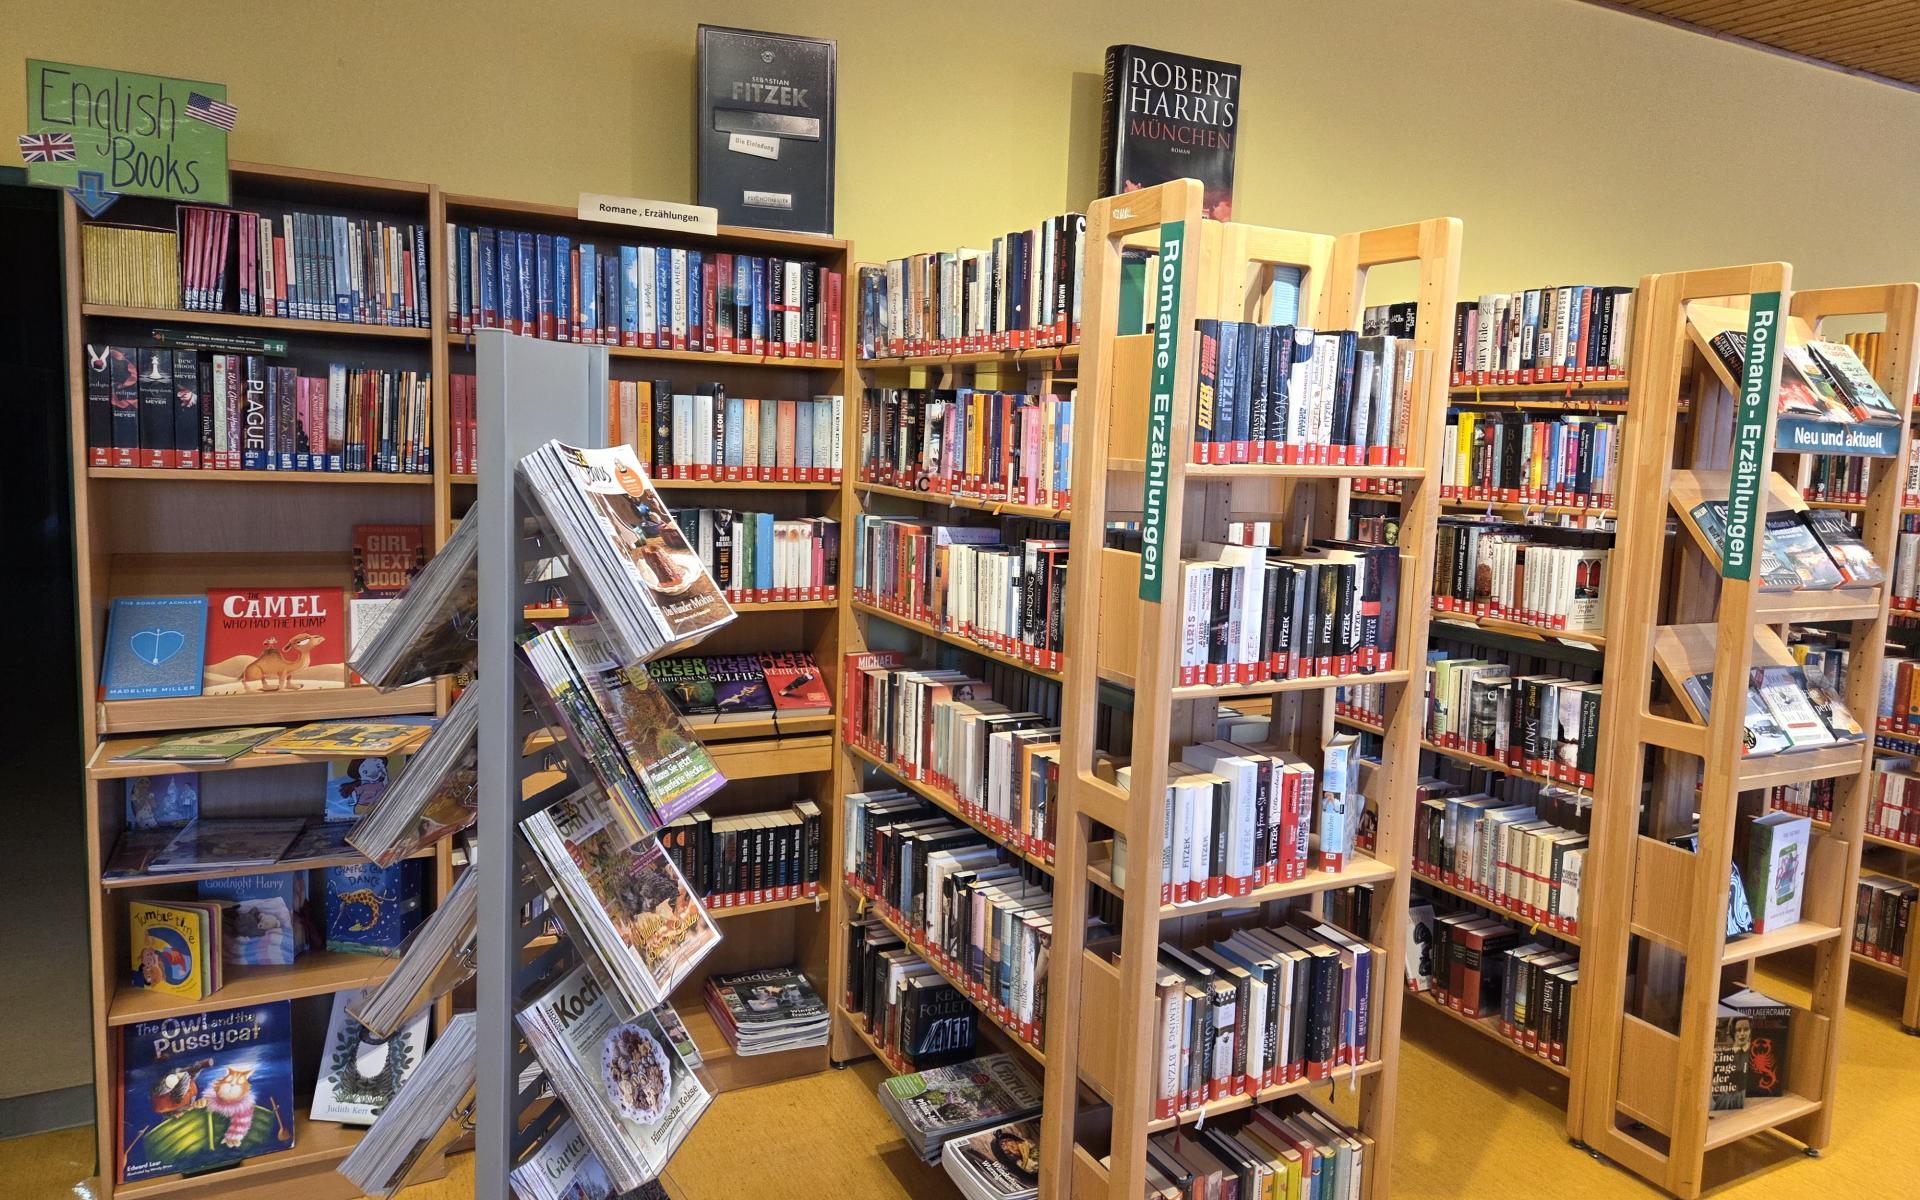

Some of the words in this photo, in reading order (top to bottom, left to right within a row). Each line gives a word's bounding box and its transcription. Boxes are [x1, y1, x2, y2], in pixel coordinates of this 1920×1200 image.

[752, 76, 789, 86] SEBASTIAN
[1132, 58, 1236, 99] ROBERT
[732, 82, 808, 107] FITZEK
[1130, 86, 1233, 127] HARRIS
[41, 67, 176, 156] English
[736, 137, 745, 145] Die
[747, 139, 774, 152] Einladung
[1131, 119, 1230, 149] MÜNCHEN
[112, 137, 200, 195] Books
[599, 203, 637, 215] Romane
[645, 209, 699, 222] Erzählungen
[1058, 284, 1066, 307] BROWN
[1156, 239, 1180, 369] Romane
[1745, 310, 1774, 407] Romane
[1222, 366, 1233, 422] FITZEK
[247, 380, 264, 450] PLAGUE
[1198, 382, 1214, 431] FITZEK
[1272, 391, 1288, 438] NOAH
[1323, 399, 1332, 428] FITZEK
[1253, 399, 1261, 442] SEBASTIAN
[1311, 403, 1320, 435] FITZEK
[716, 430, 724, 450] FALL
[1795, 427, 1818, 444] Neu
[1821, 430, 1844, 446] und
[1846, 431, 1883, 448] aktuell
[716, 451, 724, 465] DER
[918, 476, 930, 492] C
[1143, 393, 1169, 581] Erzählungen
[1727, 424, 1761, 566] Erzählungen
[367, 535, 410, 552] GIRL
[367, 554, 411, 569] NEXT
[223, 595, 327, 619] CAMEL
[690, 594, 715, 609] Mohn
[1025, 575, 1035, 629] BLENDUNG
[223, 618, 246, 630] WHO
[249, 618, 270, 629] HAD
[272, 617, 290, 629] THE
[293, 616, 326, 629] HUMP
[1186, 615, 1196, 655] AURIS
[1282, 616, 1290, 647] FITZEK
[1323, 612, 1332, 644] FITZEK
[1342, 612, 1350, 645] FITZEK
[650, 657, 705, 669] ADLER
[650, 666, 707, 677] OLSEN
[707, 663, 762, 675] OLSEN
[763, 666, 820, 677] VERRATEN
[858, 656, 894, 667] MICHAEL
[709, 671, 766, 684] SELFIES
[110, 687, 157, 695] MADELINE
[161, 685, 196, 693] MILLER
[1528, 684, 1537, 707] Schuld
[1524, 720, 1537, 753] LINK
[684, 765, 705, 779] Hecke
[1243, 829, 1251, 866] FITZEK
[1270, 826, 1278, 854] FITZEK
[1298, 821, 1306, 852] AURIS
[1182, 838, 1191, 868] FITZEK
[205, 877, 252, 894] Goodnight
[256, 877, 284, 891] Harry
[348, 875, 380, 887] DANCE
[133, 910, 174, 931] Tumble
[175, 912, 196, 946] time
[721, 968, 793, 985] Landlust
[936, 991, 963, 1002] KEN
[1542, 980, 1553, 1013] Mankell
[1753, 1007, 1791, 1017] LAGERCRANTZ
[136, 1022, 159, 1037] The
[161, 1013, 207, 1039] Owl
[211, 1014, 234, 1029] and
[236, 1011, 256, 1026] the
[154, 1024, 262, 1060] Pussycat
[1713, 1052, 1735, 1062] Eine
[1713, 1063, 1737, 1073] rage
[1713, 1074, 1730, 1083] der
[327, 1105, 351, 1114] Judith
[352, 1106, 369, 1115] Kerr
[650, 1104, 681, 1146] Himmlische
[678, 1084, 699, 1109] Kekse
[127, 1162, 148, 1172] Edward
